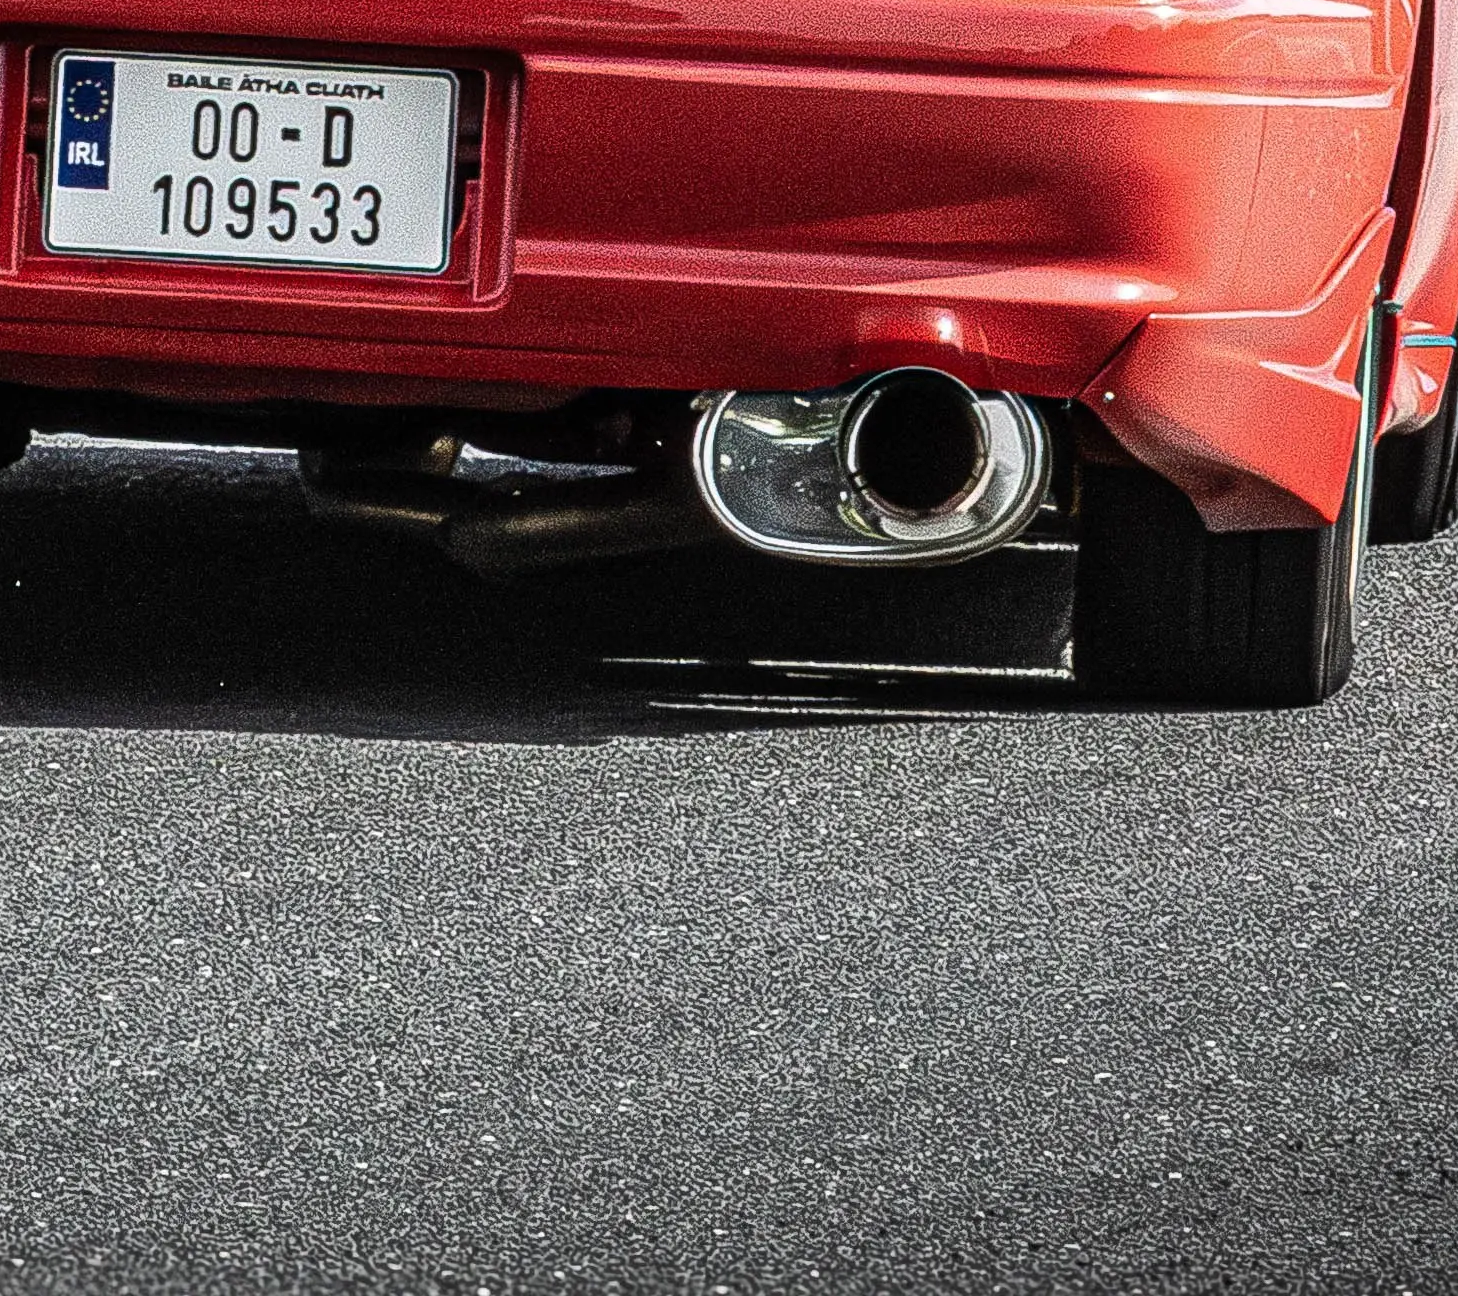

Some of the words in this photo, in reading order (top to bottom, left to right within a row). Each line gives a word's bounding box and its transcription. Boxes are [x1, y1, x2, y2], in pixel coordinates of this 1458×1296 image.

[167, 73, 233, 91] BAILE
[67, 141, 105, 166] IRL
[152, 174, 382, 246] 109533
